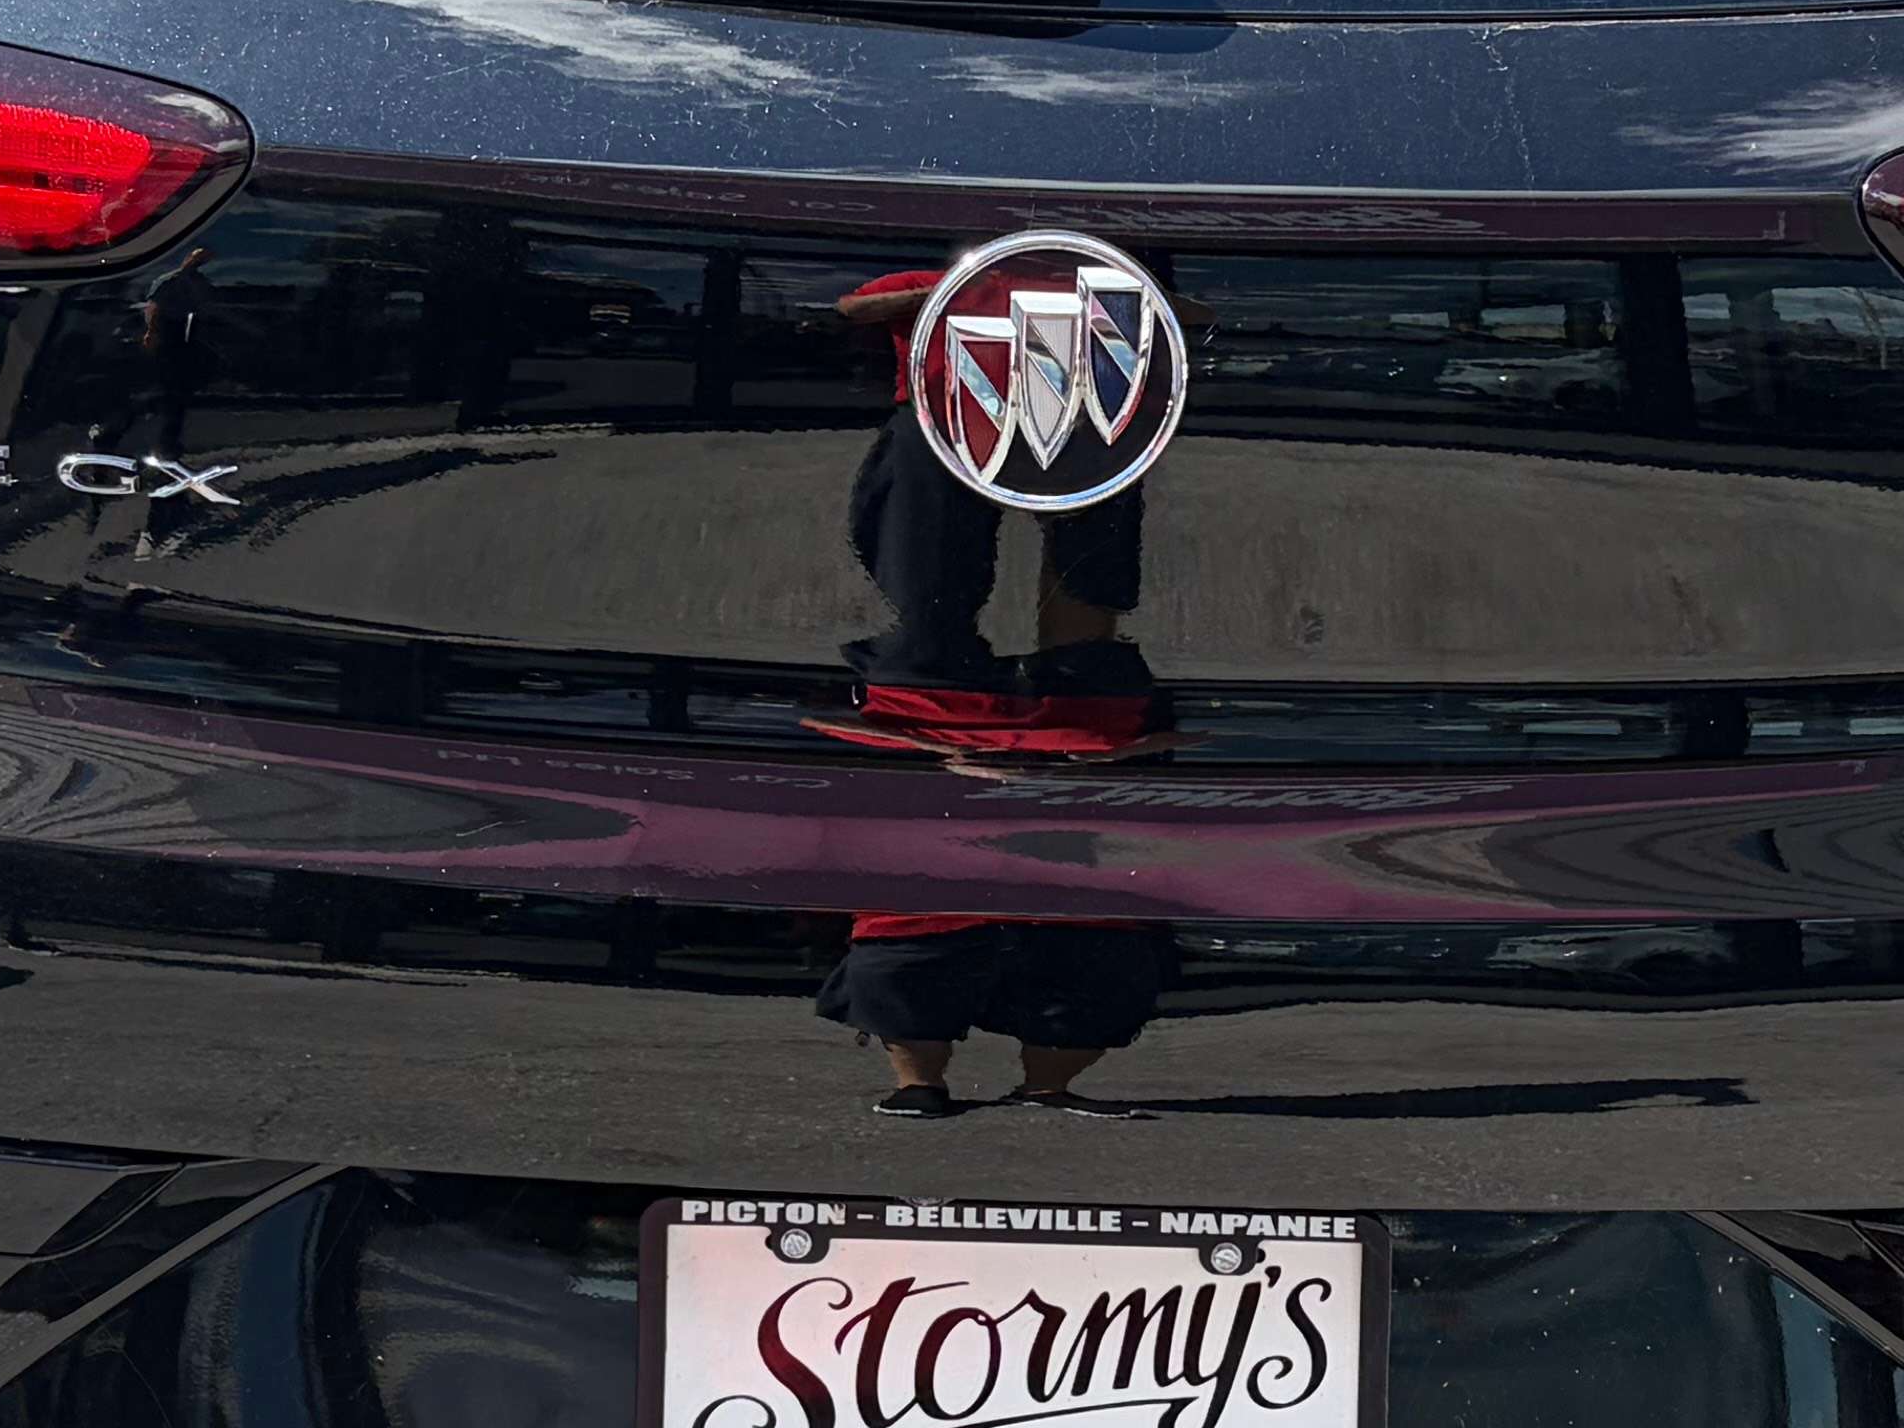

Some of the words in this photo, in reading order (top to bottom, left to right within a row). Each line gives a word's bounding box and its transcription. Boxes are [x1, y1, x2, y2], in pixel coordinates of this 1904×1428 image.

[56, 452, 240, 505] GX
[681, 1200, 846, 1226] PICTON
[885, 1204, 1123, 1233] BELLEVILLE
[1159, 1212, 1356, 1240] NAPANEE
